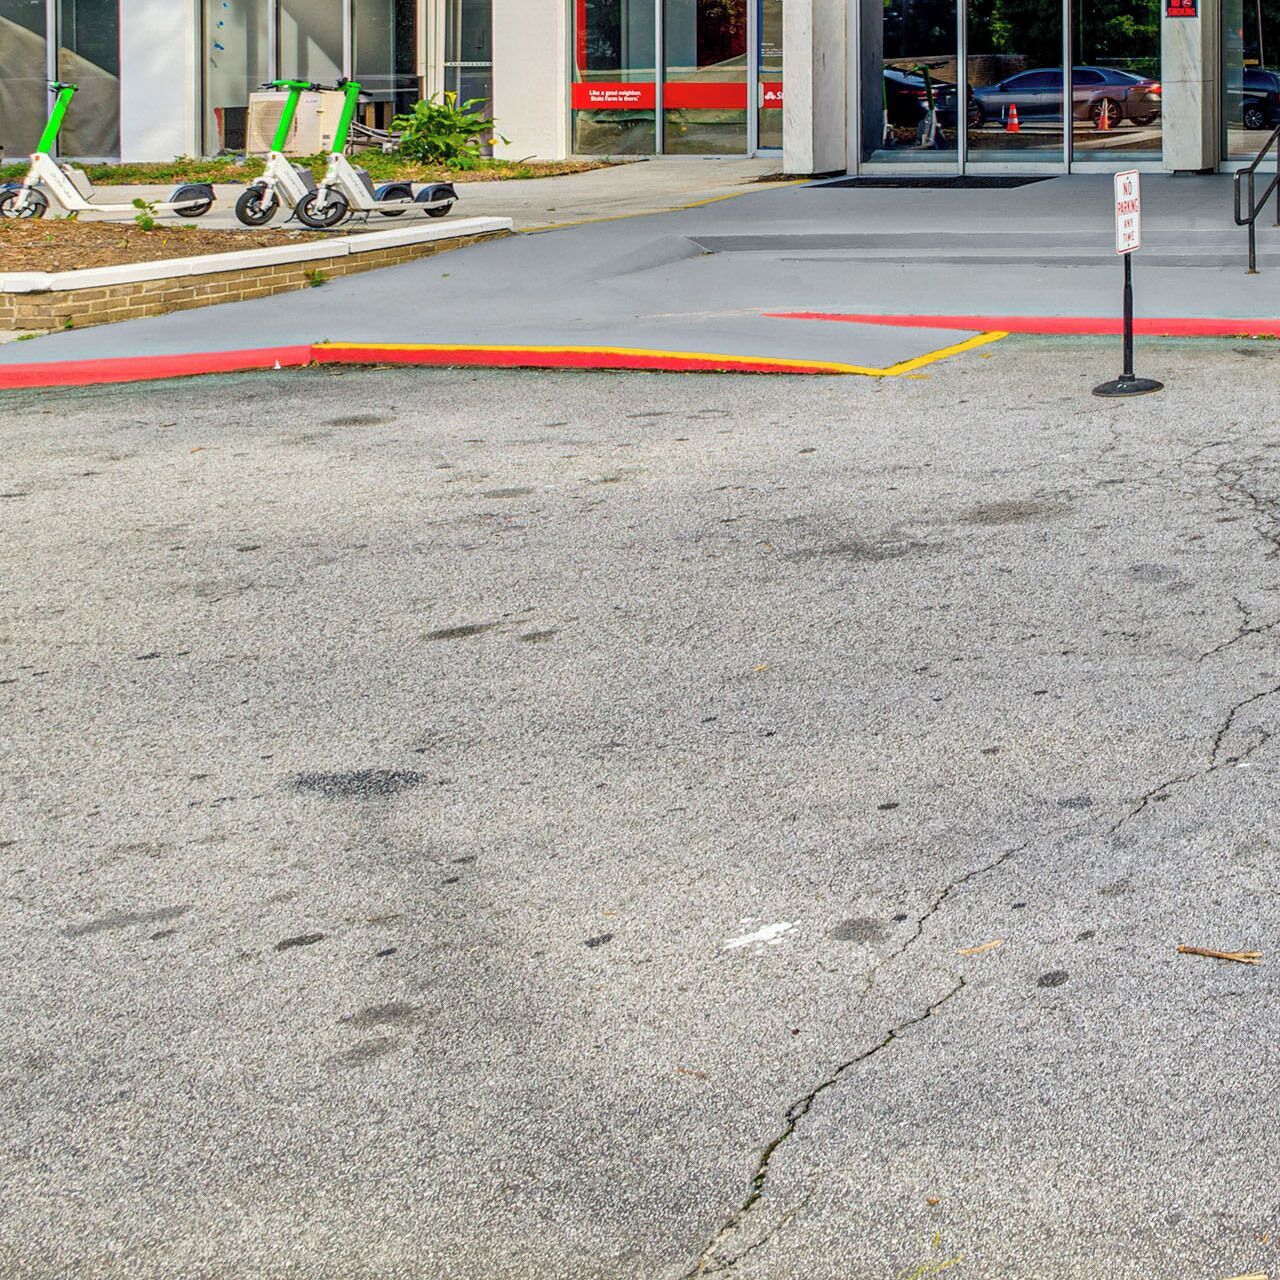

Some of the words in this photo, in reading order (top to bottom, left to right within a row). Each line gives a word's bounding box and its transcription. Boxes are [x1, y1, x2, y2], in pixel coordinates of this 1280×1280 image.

[1167, 7, 1196, 16] SMOKING
[1123, 181, 1132, 196] NO
[1117, 199, 1139, 216] PARKING
[1124, 219, 1133, 229] ANY
